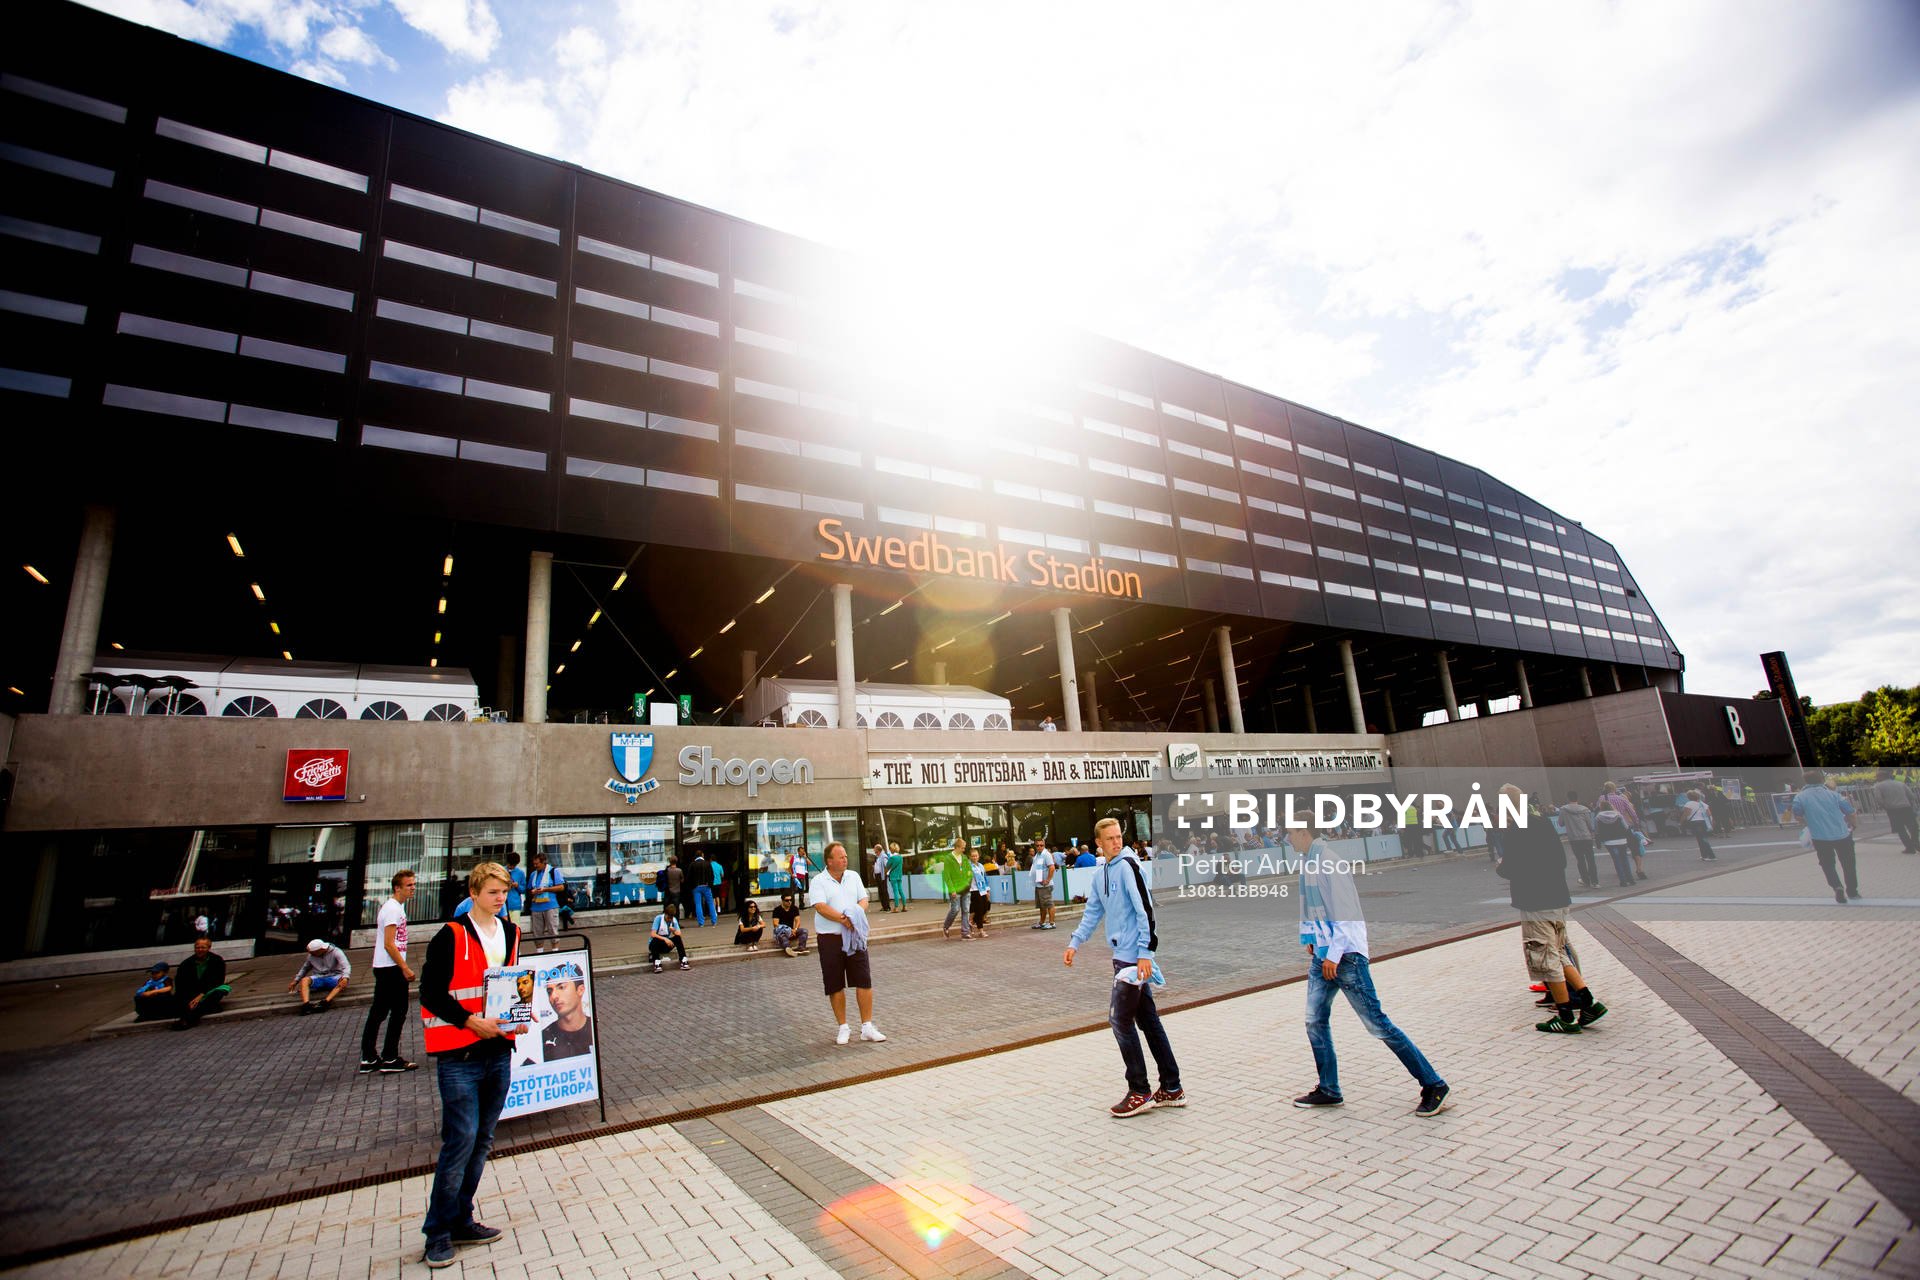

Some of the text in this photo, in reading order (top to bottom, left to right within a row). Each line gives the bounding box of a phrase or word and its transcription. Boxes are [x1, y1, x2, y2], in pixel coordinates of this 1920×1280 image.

[818, 518, 1143, 599] Swedbank Stadion
[1727, 705, 1746, 745] B
[678, 745, 814, 798] Shopen
[884, 760, 1150, 785] THE NO1 SPORTSBAR BAR & RESTAURANT
[1215, 755, 1377, 776] THE NO1 SPORTSBAR BAR & RESTAURANT
[705, 827, 720, 841] 11
[511, 1067, 591, 1093] STÖTTADE VI
[536, 1091, 540, 1102] I
[543, 1080, 594, 1101] EUROPA
